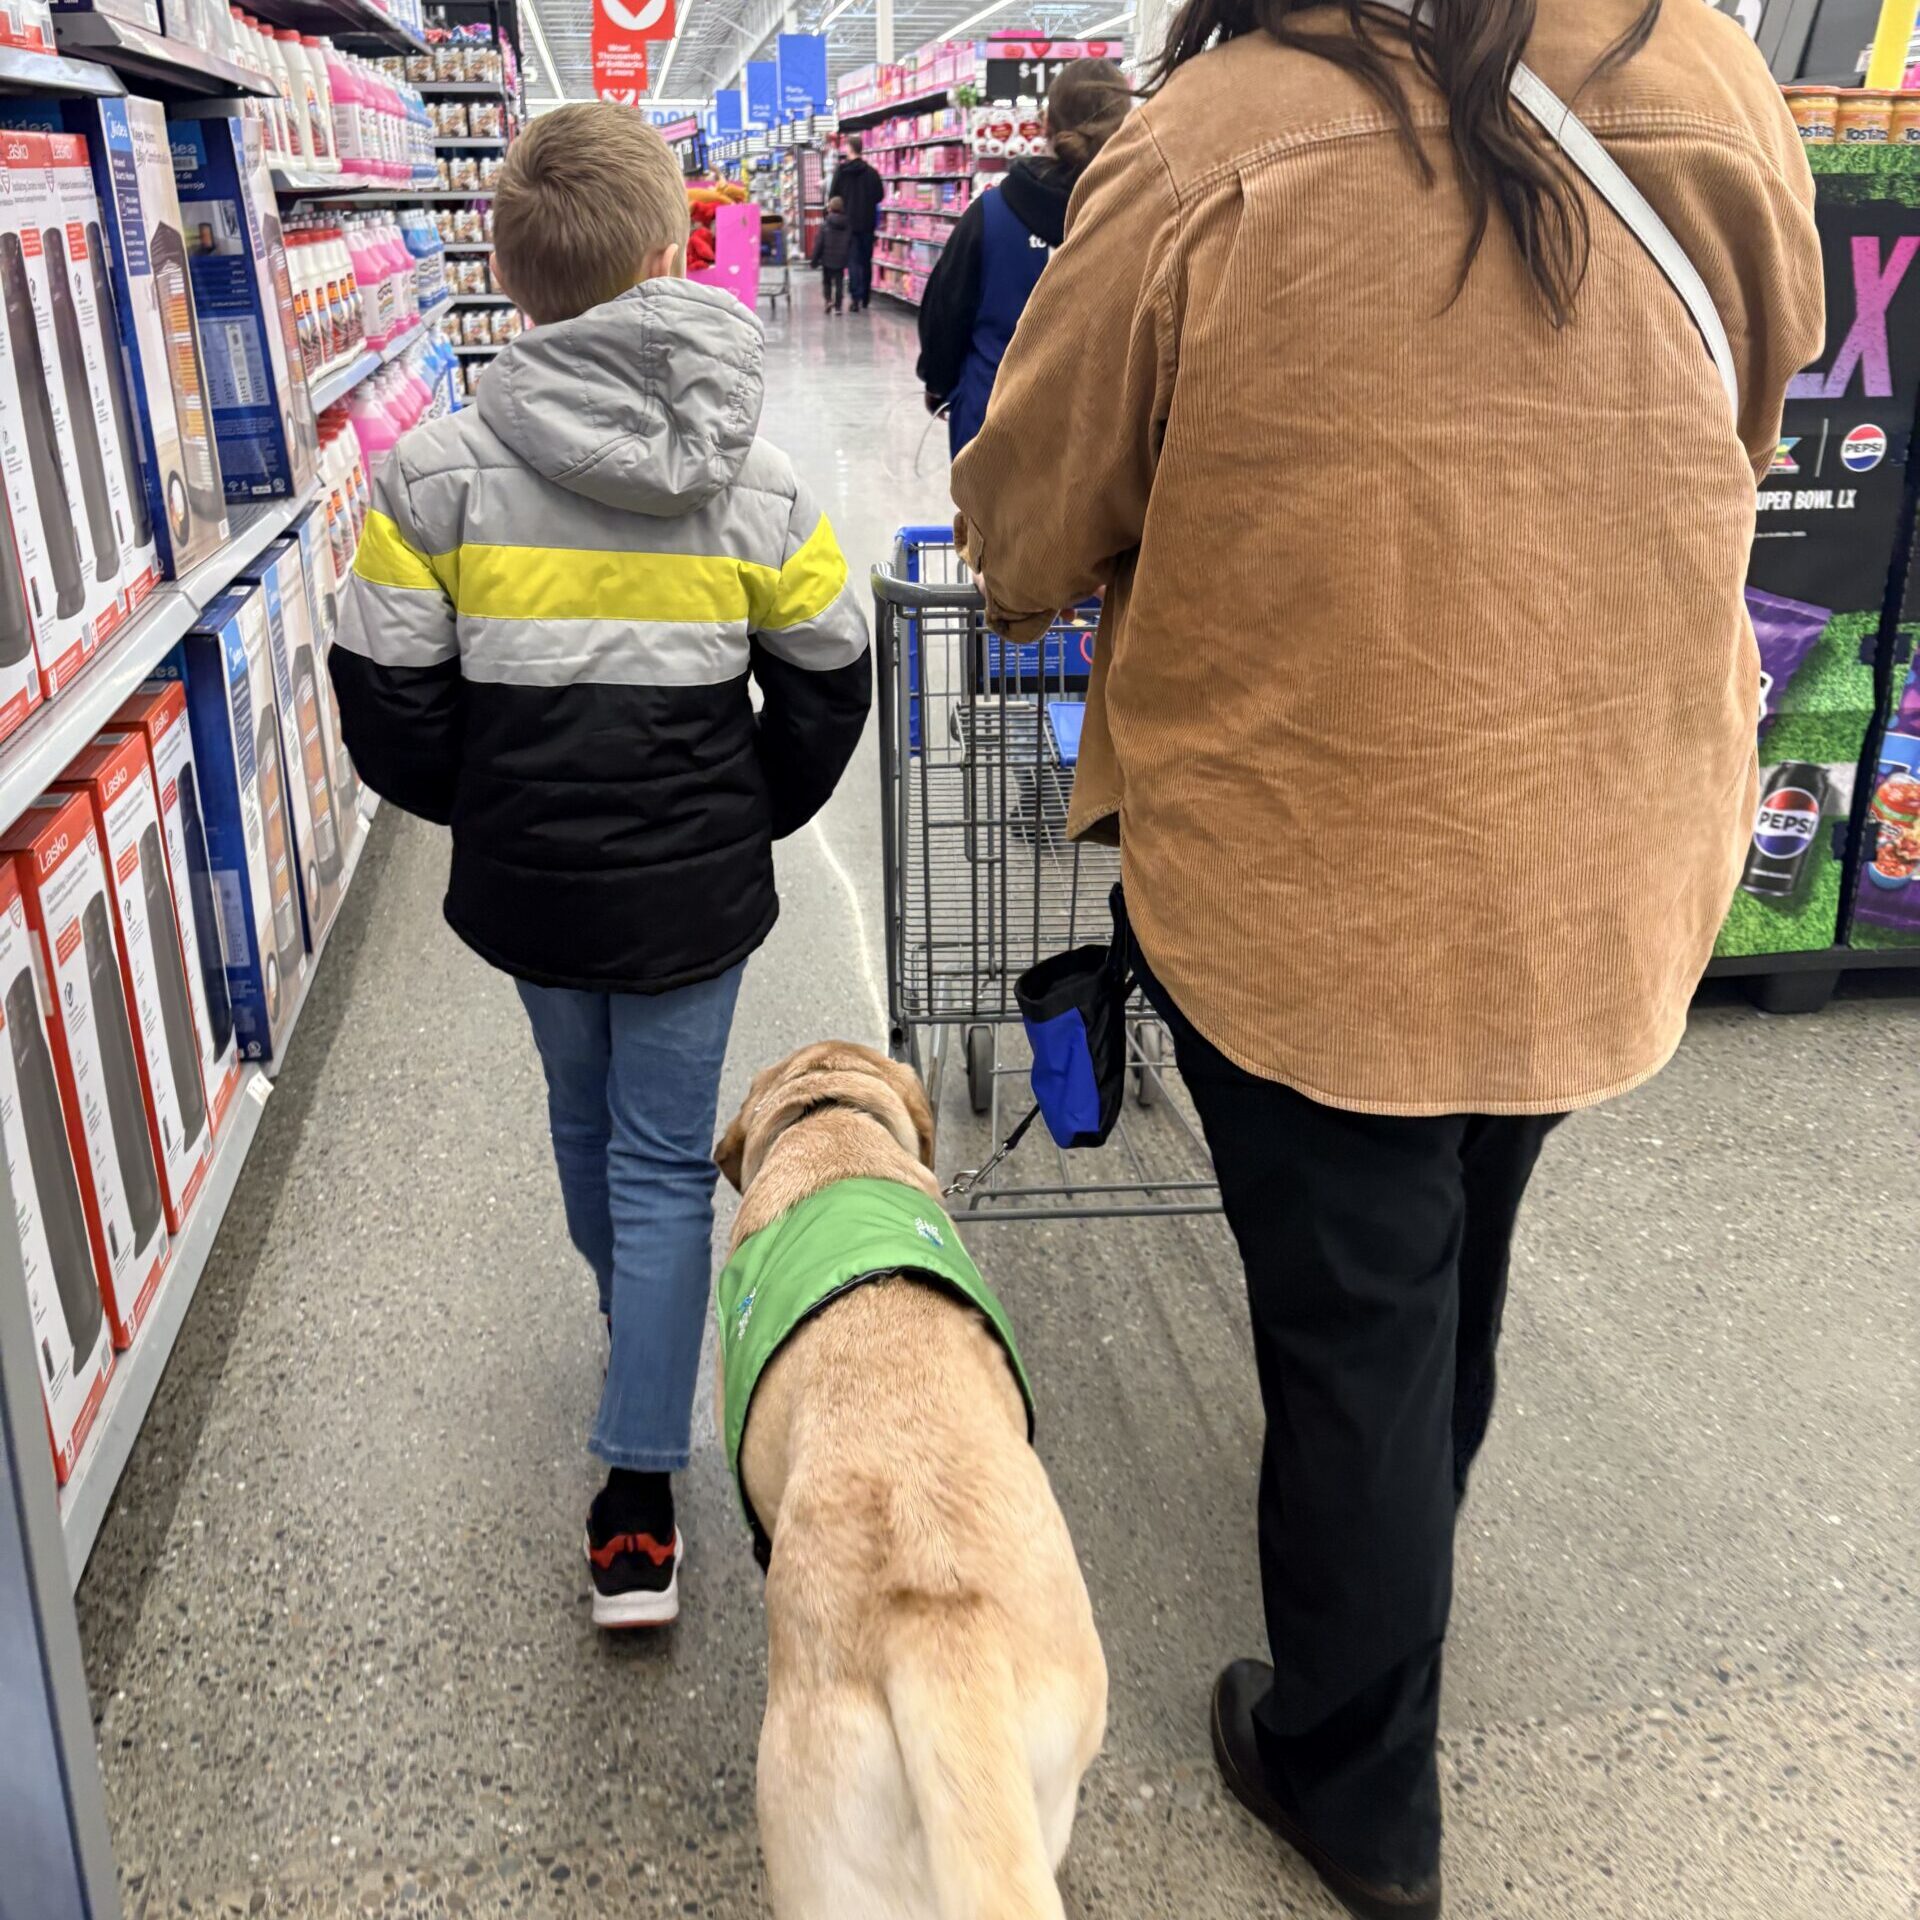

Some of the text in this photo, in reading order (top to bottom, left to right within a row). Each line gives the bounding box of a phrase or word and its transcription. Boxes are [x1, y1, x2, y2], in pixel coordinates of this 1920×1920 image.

[1785, 236, 1920, 398] X
[1845, 442, 1882, 453] PEPSI
[1757, 488, 1858, 511] UPER BOWL LX
[102, 766, 128, 801] Lasko
[1759, 811, 1816, 835] PEPSI
[38, 832, 70, 875] Lasko
